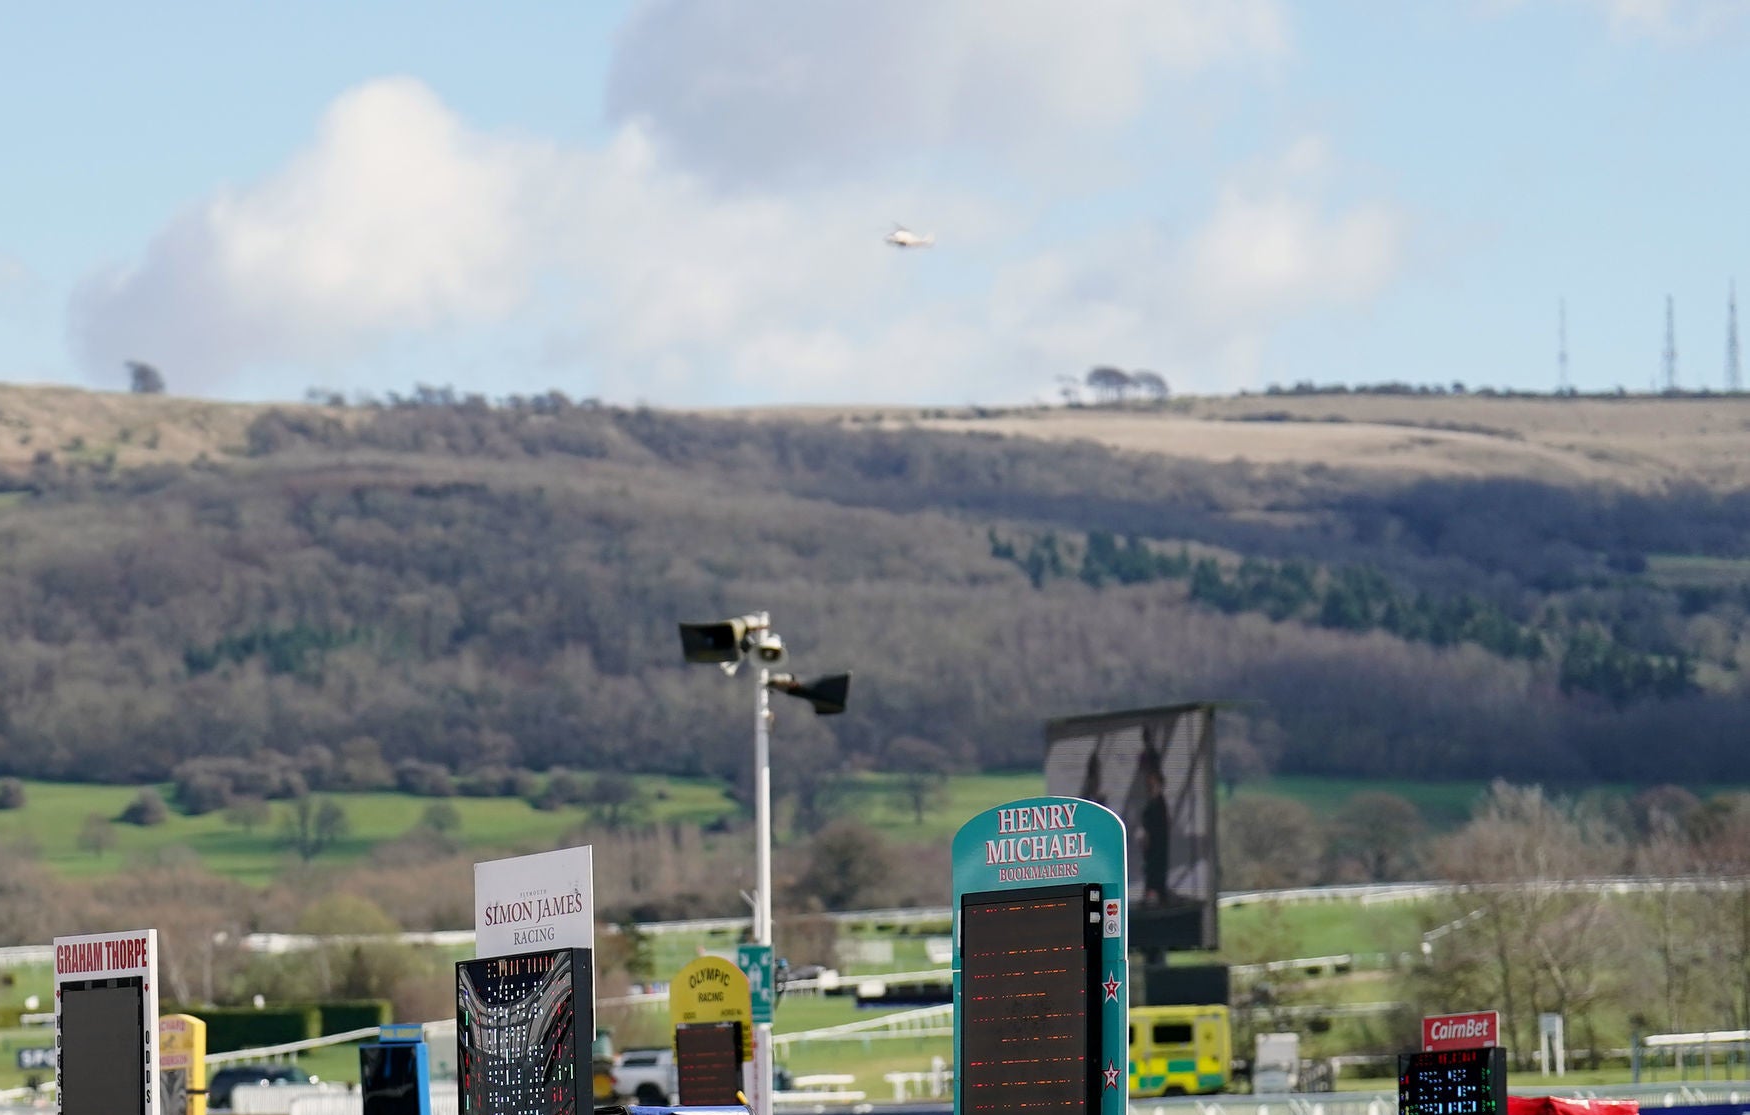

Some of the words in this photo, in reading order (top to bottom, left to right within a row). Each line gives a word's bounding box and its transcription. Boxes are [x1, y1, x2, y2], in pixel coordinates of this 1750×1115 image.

[998, 803, 1078, 834] HENRY
[985, 832, 1092, 865] MICHAEL
[999, 863, 1079, 883] BOOKMAKERS
[485, 901, 533, 926] SIMON
[536, 893, 582, 923] JAMES
[514, 927, 555, 945] RACING
[57, 942, 103, 974] GRAHAM
[105, 938, 147, 970] THORPE
[690, 967, 730, 989] OLYMPIC
[698, 992, 724, 1003] RACING
[1431, 1019, 1489, 1040] CairnBet
